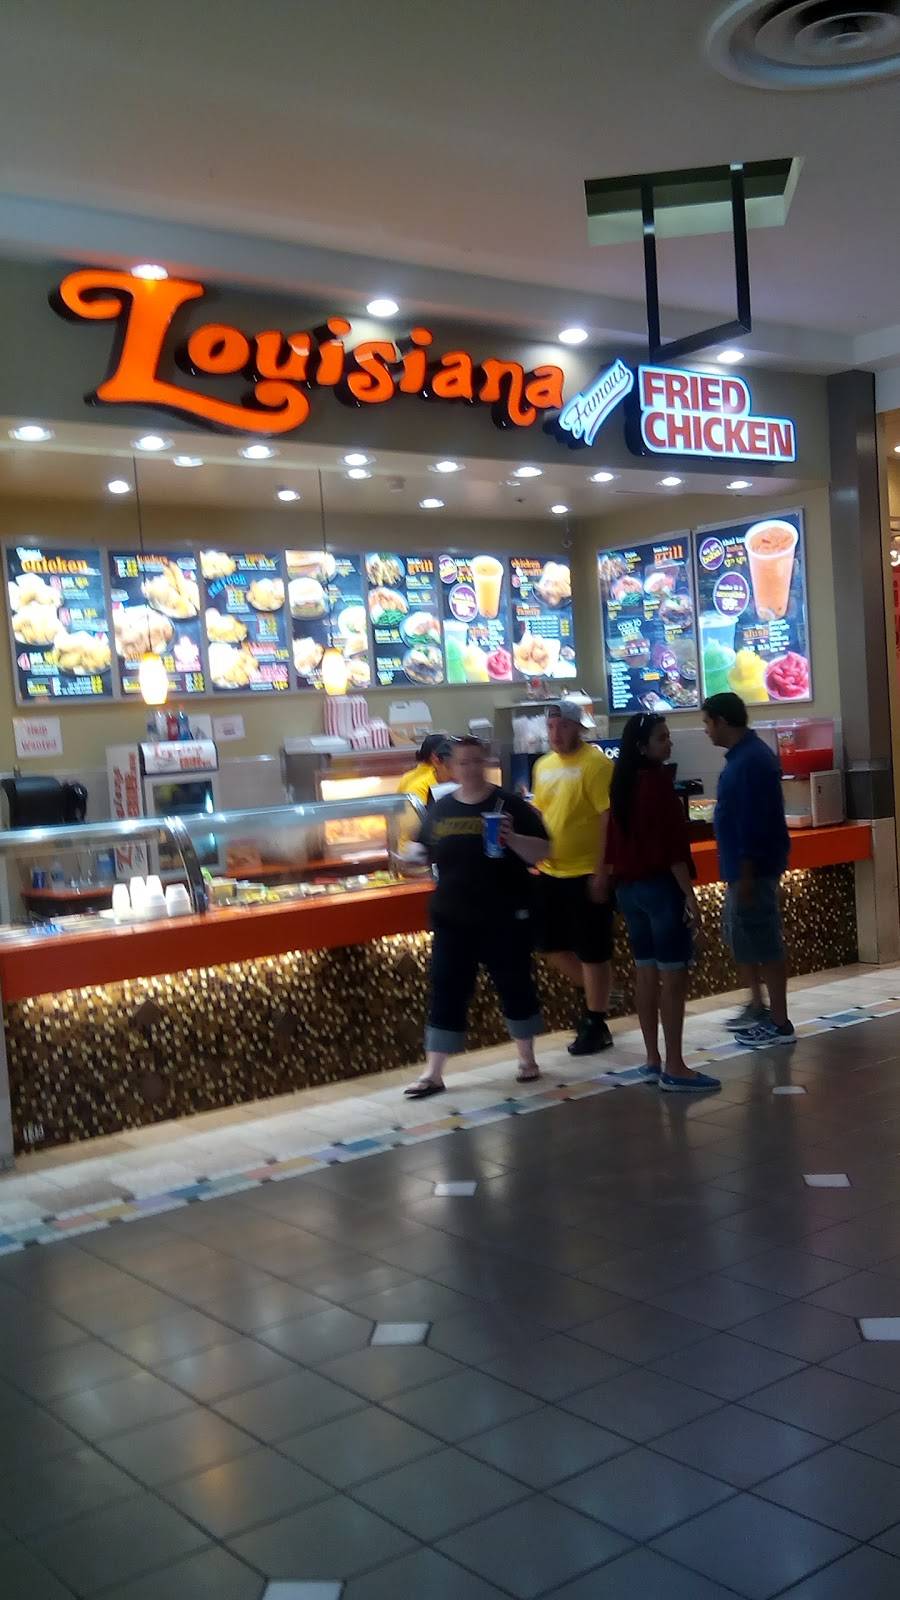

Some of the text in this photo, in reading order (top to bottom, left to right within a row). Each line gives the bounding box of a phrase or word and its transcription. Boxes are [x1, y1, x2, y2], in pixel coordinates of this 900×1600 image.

[59, 269, 564, 434] Louisiana
[563, 362, 632, 436] Famous
[642, 370, 747, 415] FRIED
[644, 411, 793, 458] CHICKEN
